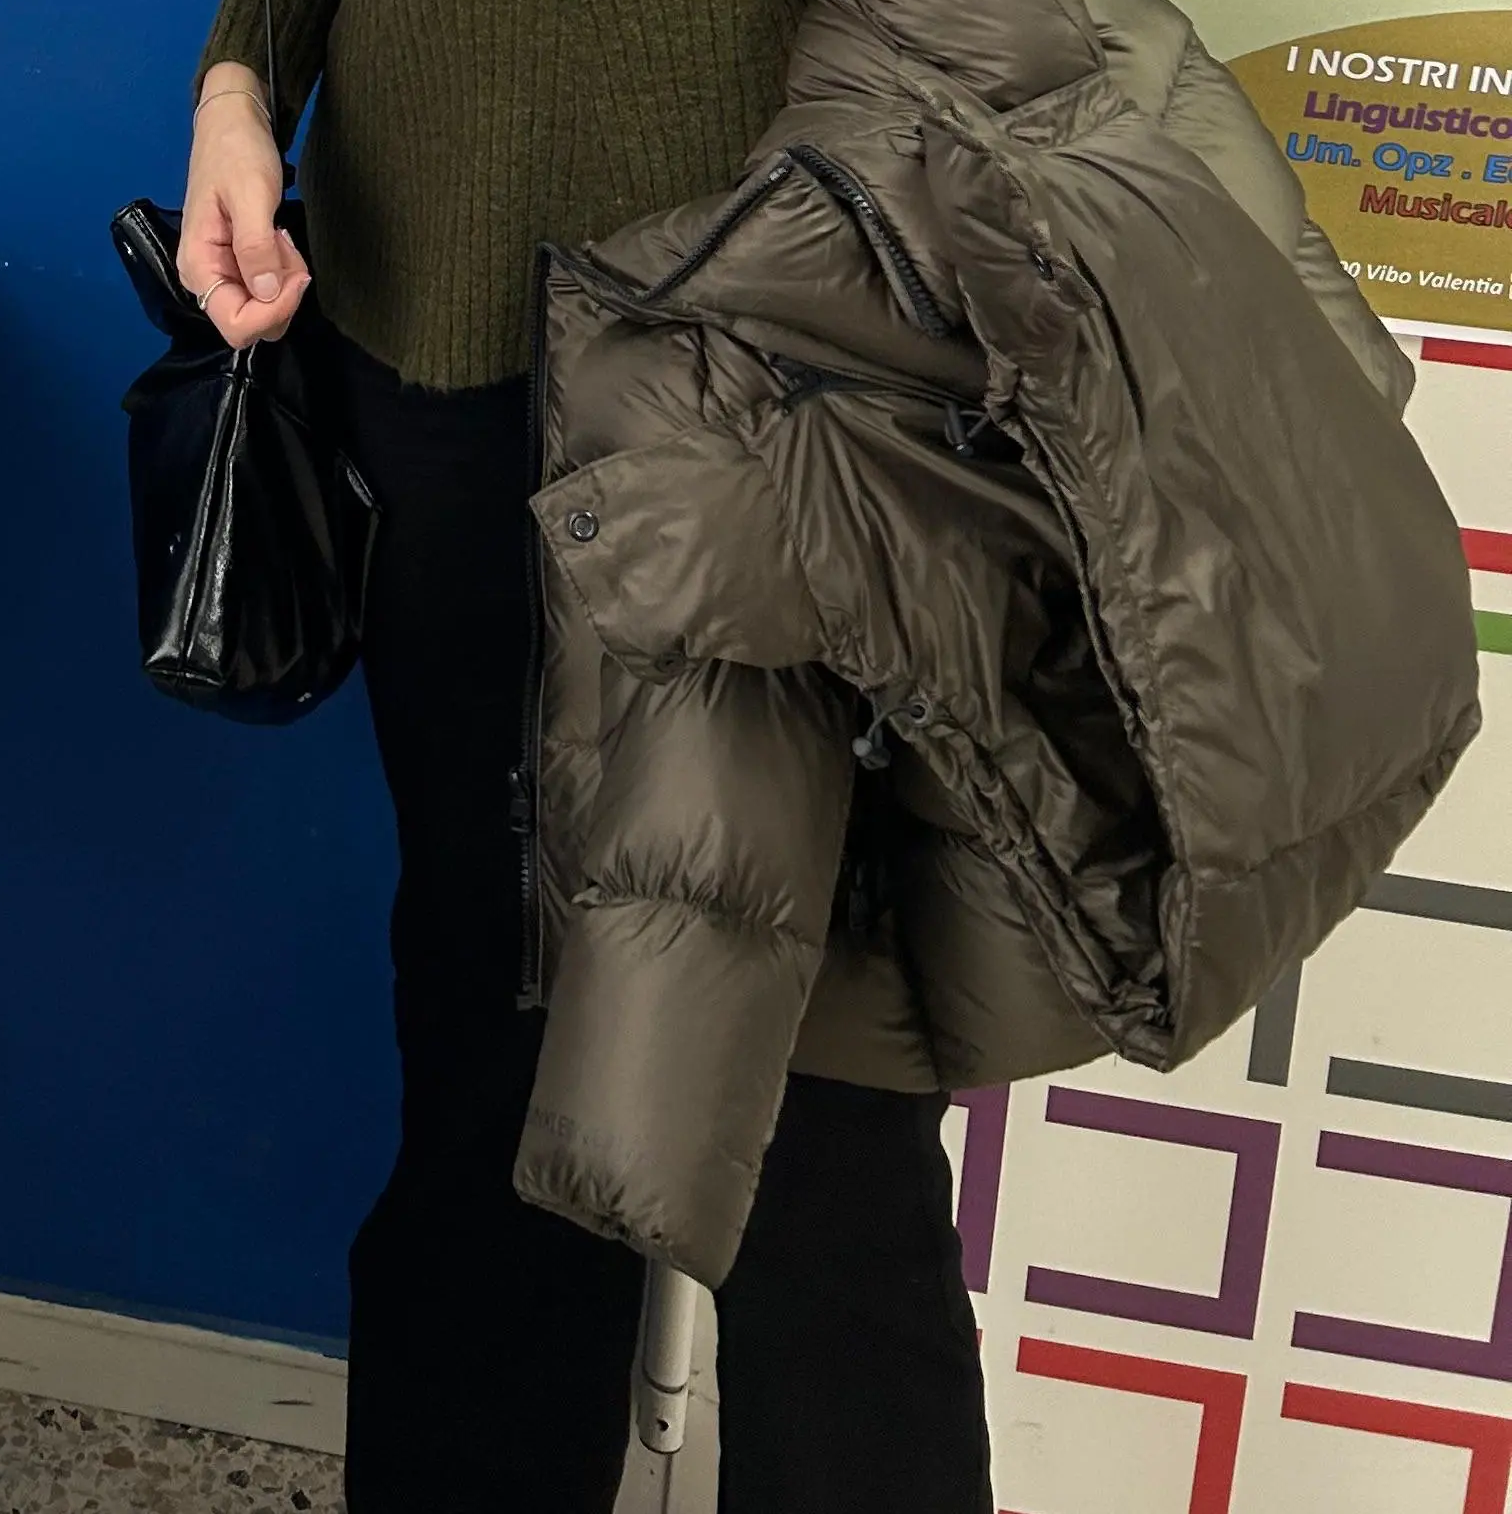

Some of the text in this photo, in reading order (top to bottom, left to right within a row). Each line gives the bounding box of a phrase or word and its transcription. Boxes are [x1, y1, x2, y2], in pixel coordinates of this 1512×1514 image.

[1287, 46, 1299, 72] I
[1308, 48, 1459, 90] NOSTRI
[1303, 91, 1512, 140] Linguistico
[1286, 132, 1362, 167] Um.
[1372, 141, 1454, 181] Opz
[1367, 264, 1412, 285] Vibo
[1418, 269, 1504, 295] Valentia
